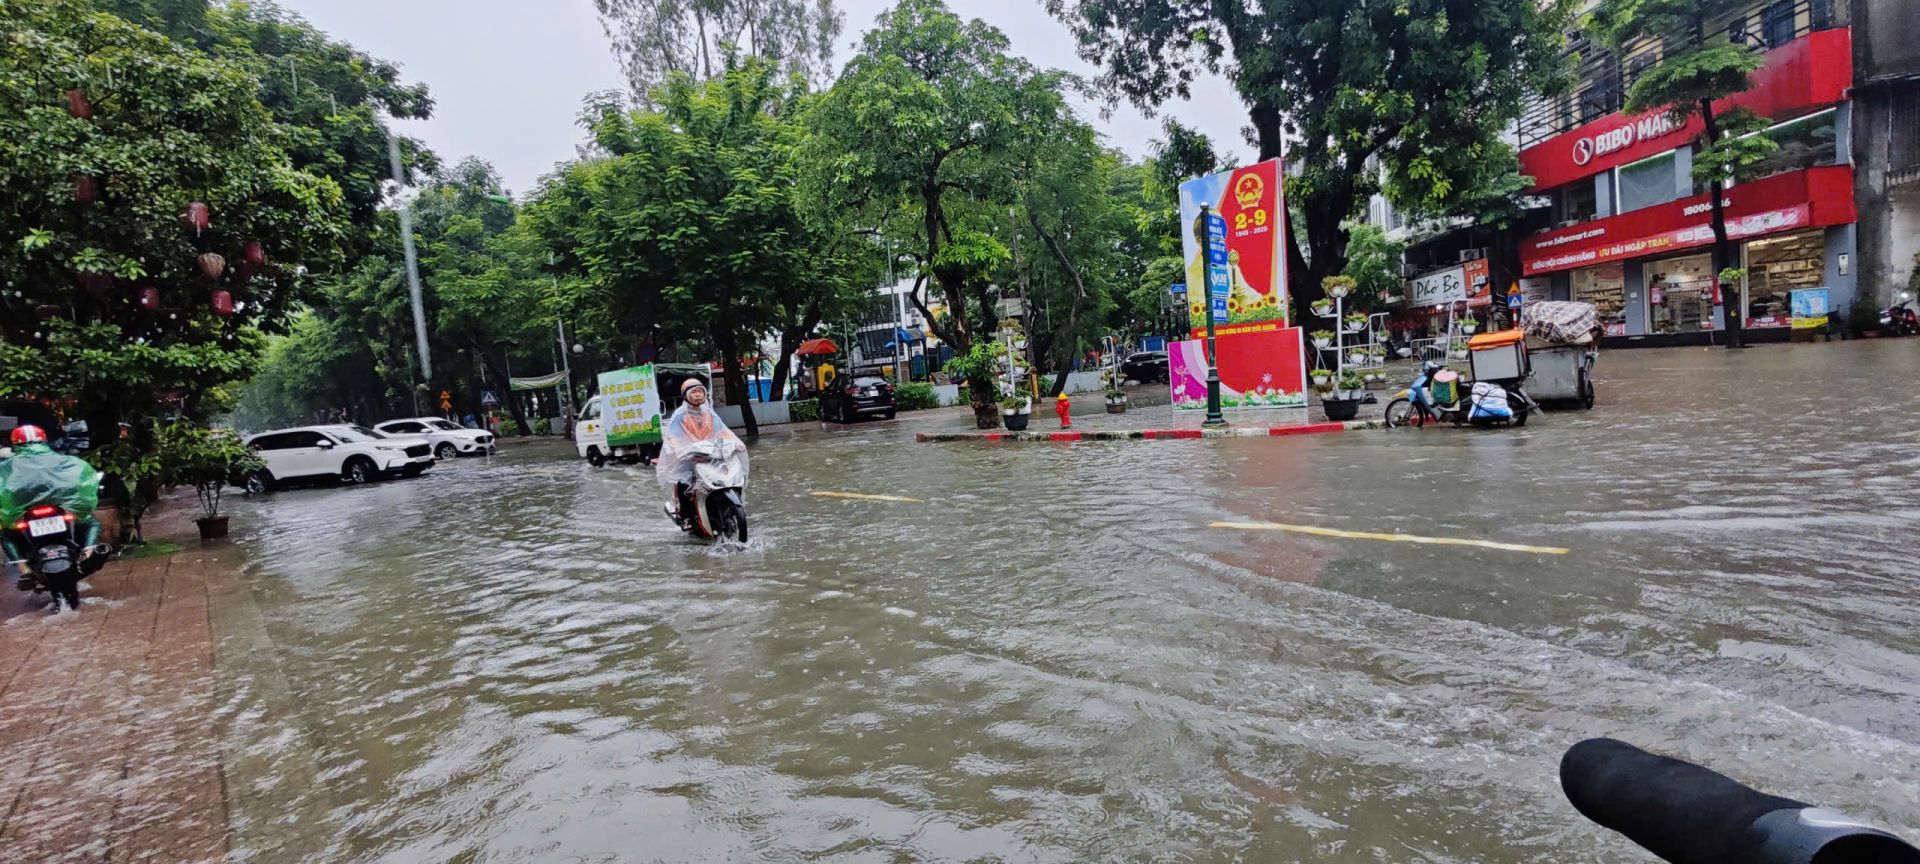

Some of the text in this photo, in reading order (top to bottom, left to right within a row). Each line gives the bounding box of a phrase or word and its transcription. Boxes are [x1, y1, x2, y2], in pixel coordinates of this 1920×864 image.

[1595, 122, 1636, 156] BIBO
[1683, 198, 1731, 217] 180066
[1235, 209, 1266, 230] 2-9
[1253, 225, 1268, 234] 2025
[1535, 228, 1605, 248] www.bibomart.com
[1416, 279, 1440, 299] Phở
[1442, 274, 1460, 293] Bò
